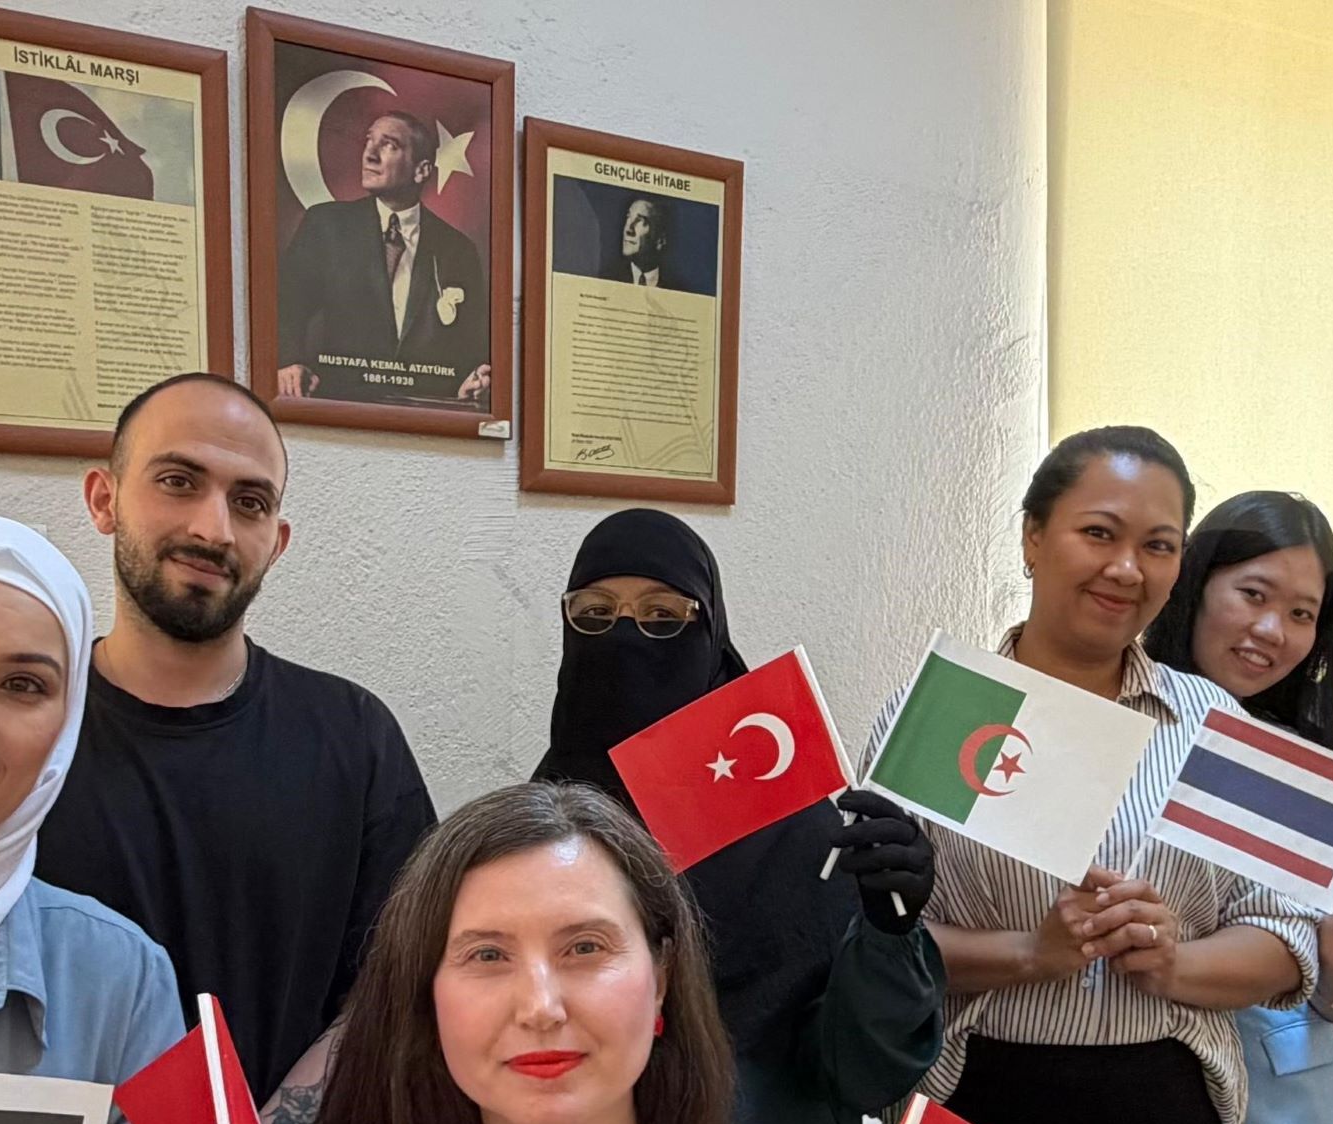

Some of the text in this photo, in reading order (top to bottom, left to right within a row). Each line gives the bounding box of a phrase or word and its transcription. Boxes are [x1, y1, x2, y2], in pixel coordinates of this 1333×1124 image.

[13, 45, 140, 85] İSTİKLÂL MARŞI
[594, 162, 692, 192] GENÇLİĞE HİTABE
[318, 354, 456, 377] MUSTAFA KEMAL ATATÜRK
[362, 372, 415, 386] 1881-1938
